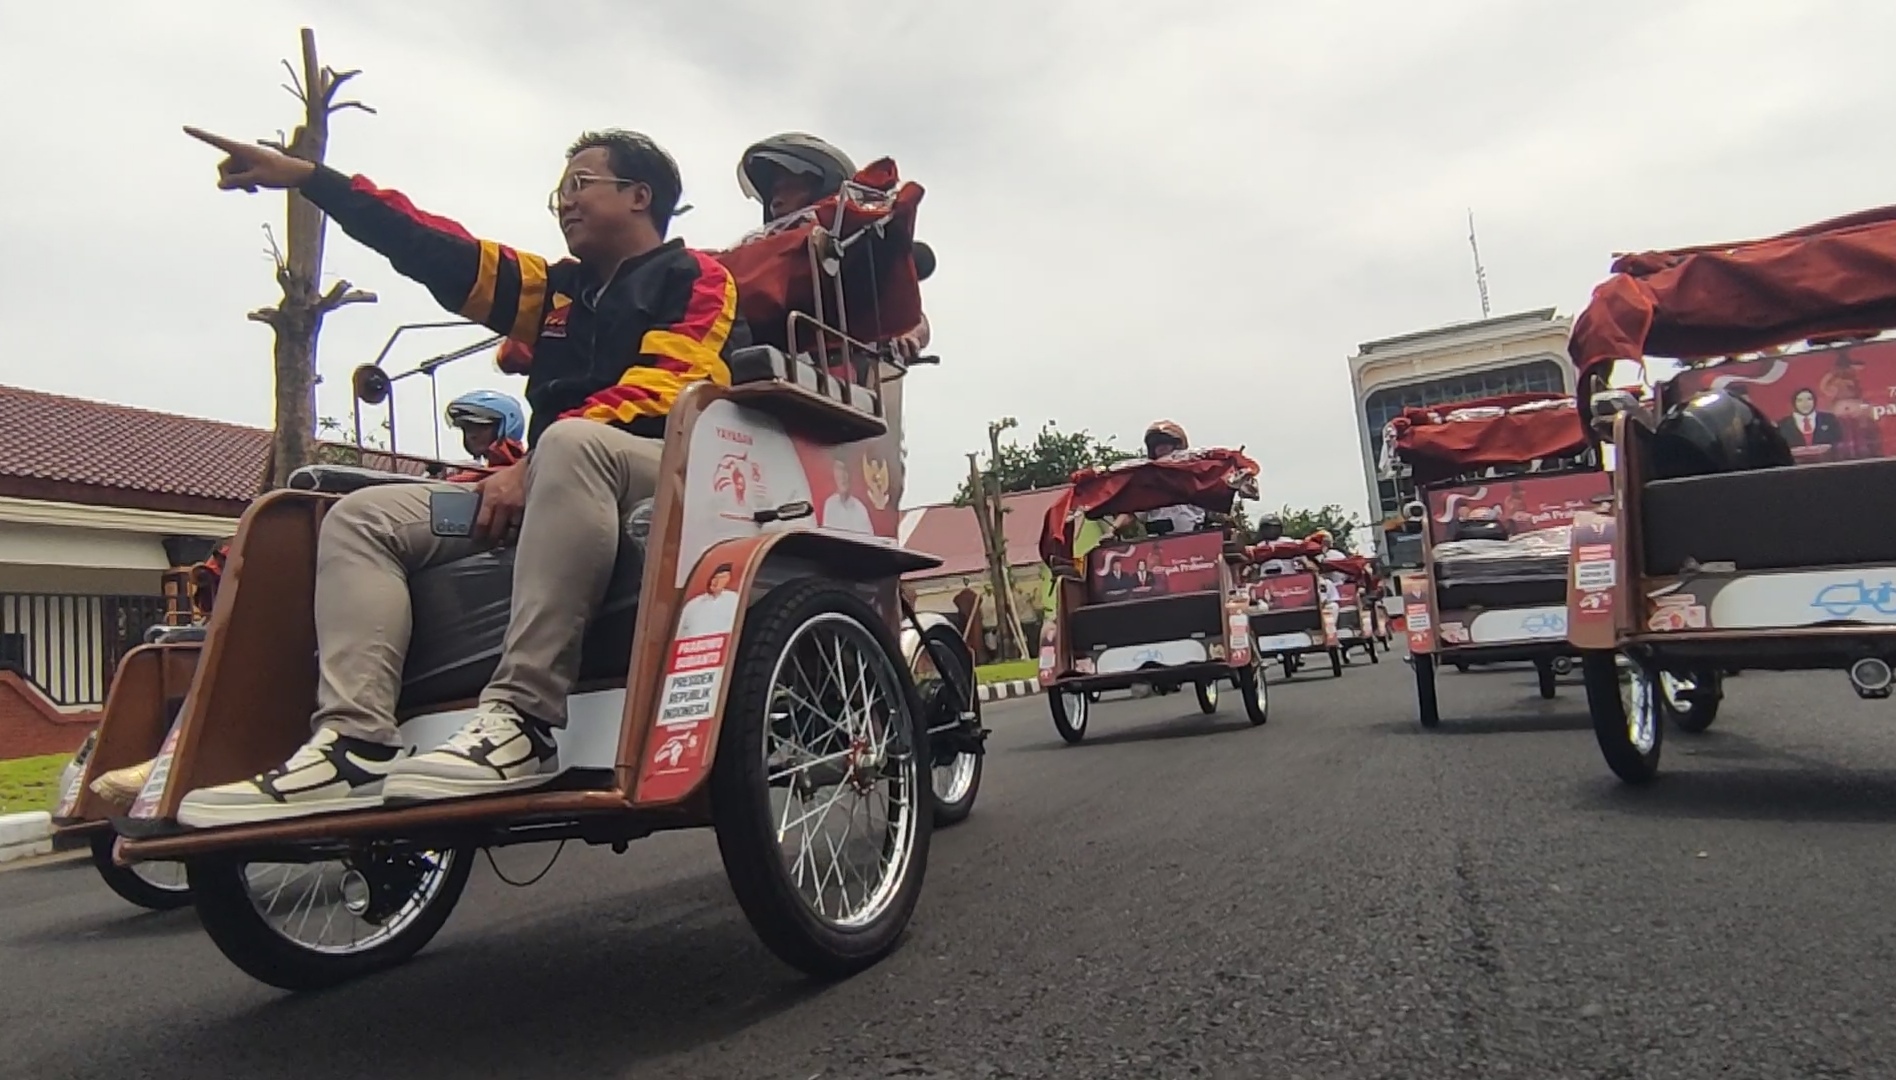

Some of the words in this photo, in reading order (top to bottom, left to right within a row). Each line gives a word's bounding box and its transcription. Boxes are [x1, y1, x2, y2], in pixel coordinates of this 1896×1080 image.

[671, 671, 716, 690] PRESIDEN
[667, 687, 712, 705] REPUBLIK
[662, 701, 710, 720] INDONESIA
